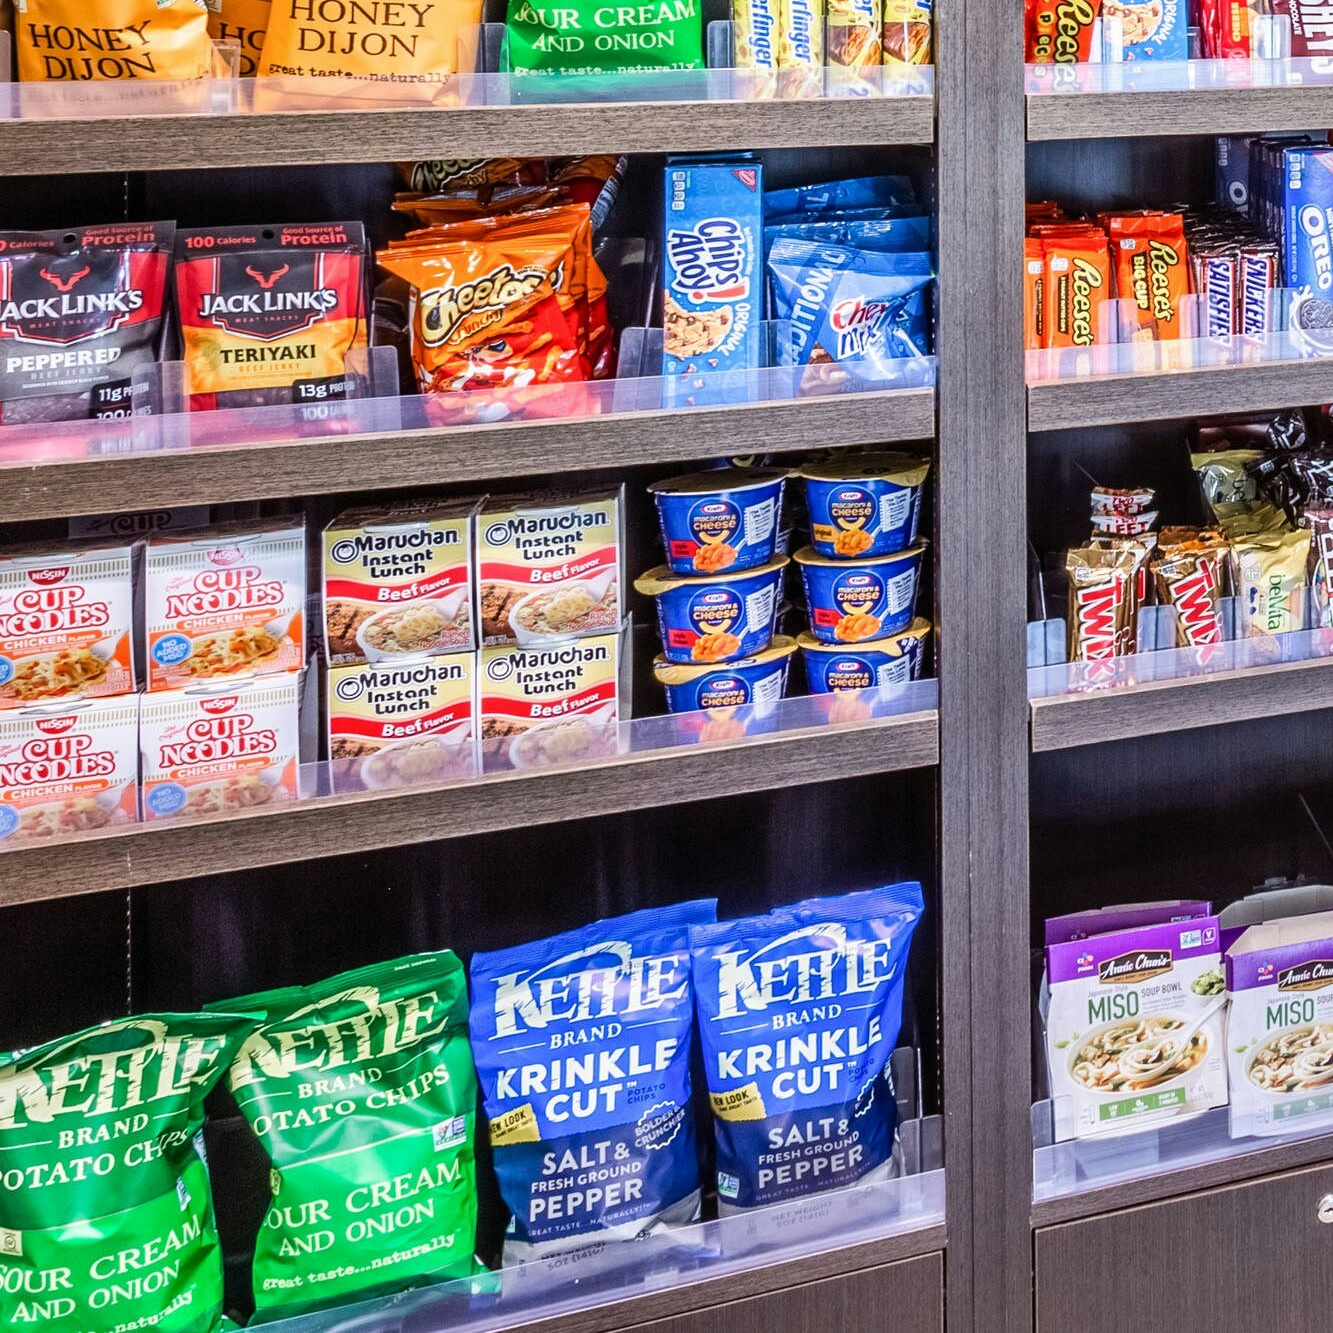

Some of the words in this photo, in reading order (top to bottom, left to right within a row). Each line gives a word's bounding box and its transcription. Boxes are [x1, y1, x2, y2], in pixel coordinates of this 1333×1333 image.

[514, 2, 580, 29] SOUR
[595, 0, 695, 27] CREAM
[298, 27, 418, 57] DIJON
[532, 34, 585, 54] AND
[595, 30, 675, 52] ONION
[185, 236, 214, 249] 100
[217, 236, 256, 245] Calories
[280, 232, 347, 245] Protein
[1299, 206, 1333, 290] OREO
[200, 293, 259, 316] JACK
[264, 288, 338, 310] LINK'S
[1208, 259, 1231, 347] SATISFIES
[7, 347, 121, 373] PEPPERED
[220, 344, 316, 365] TERIYAKI
[694, 519, 737, 531] CHEESE
[354, 529, 460, 550] Maruchan
[362, 550, 433, 567] Instant
[370, 563, 426, 578] Lunch
[194, 565, 261, 592] CUP
[378, 585, 418, 602] Beef
[420, 577, 450, 593] Flavor
[166, 590, 282, 618] NOODLES
[183, 613, 243, 625] CHICKEN
[1079, 581, 1123, 682] TWIX
[202, 699, 236, 709] NISSIN
[159, 738, 276, 768] NOODLES
[488, 941, 689, 1041] KETTLE
[1088, 992, 1140, 1024] MISO
[1141, 986, 1161, 998] SOUP
[1162, 982, 1182, 994] BOWL
[551, 1022, 622, 1050] BRAND
[497, 1038, 678, 1100] KRINKLE
[627, 1082, 666, 1097] POTATO
[627, 1093, 656, 1105] CHIPS
[542, 1141, 611, 1176] SALT
[614, 1143, 631, 1161] &
[531, 1175, 575, 1193] FRESH
[578, 1162, 642, 1186] GROUND
[262, 1199, 331, 1230] OUR
[345, 1158, 462, 1212] CREAM
[529, 1178, 643, 1222] PEPPER
